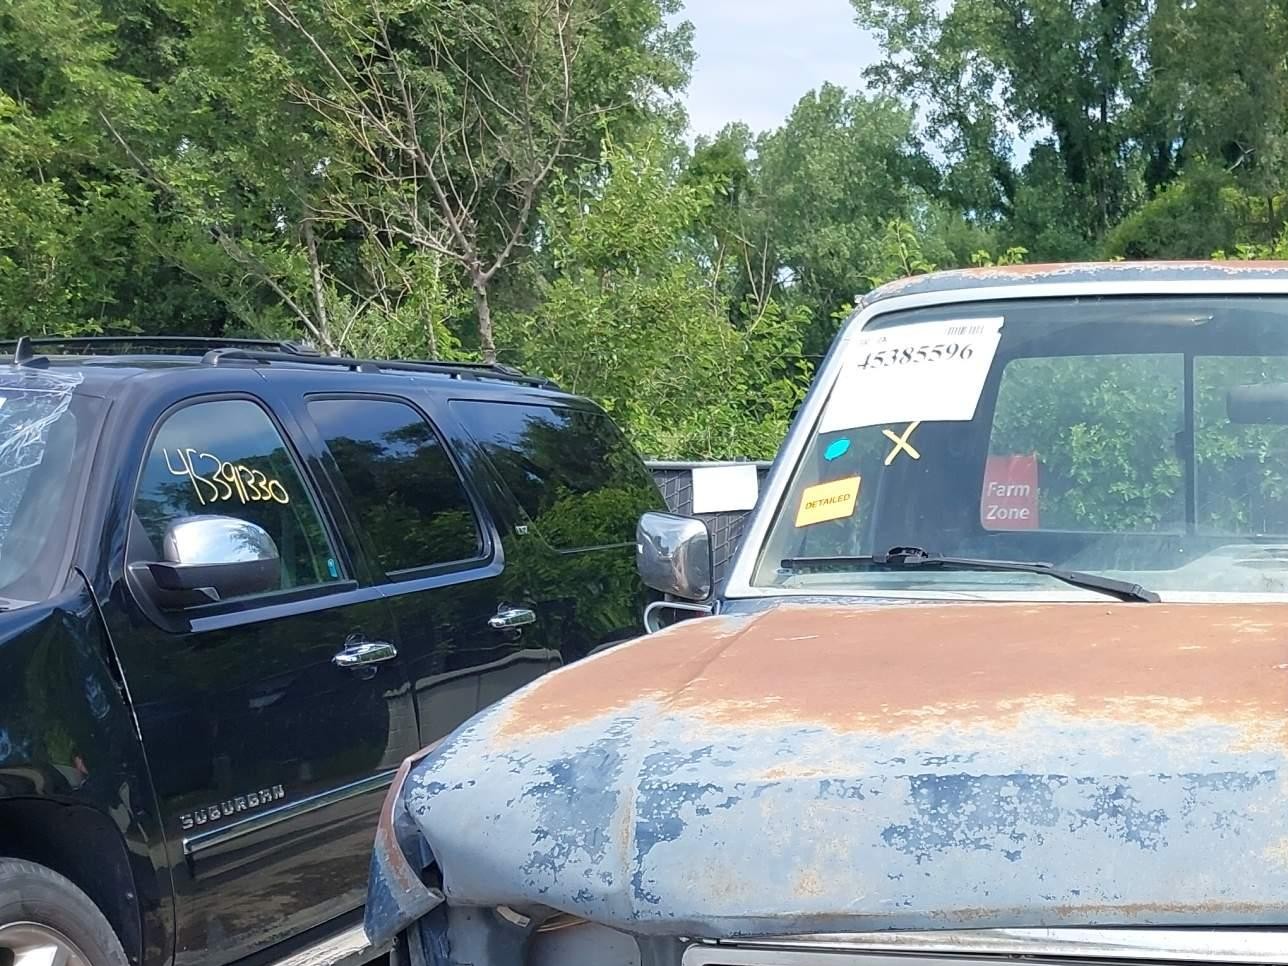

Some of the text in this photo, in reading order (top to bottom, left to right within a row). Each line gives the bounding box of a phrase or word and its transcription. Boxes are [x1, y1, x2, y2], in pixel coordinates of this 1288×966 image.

[986, 482, 1031, 497] Farm
[804, 493, 851, 511] DETAILED
[985, 504, 1031, 520] Zone
[179, 784, 285, 830] SUBURBAN
